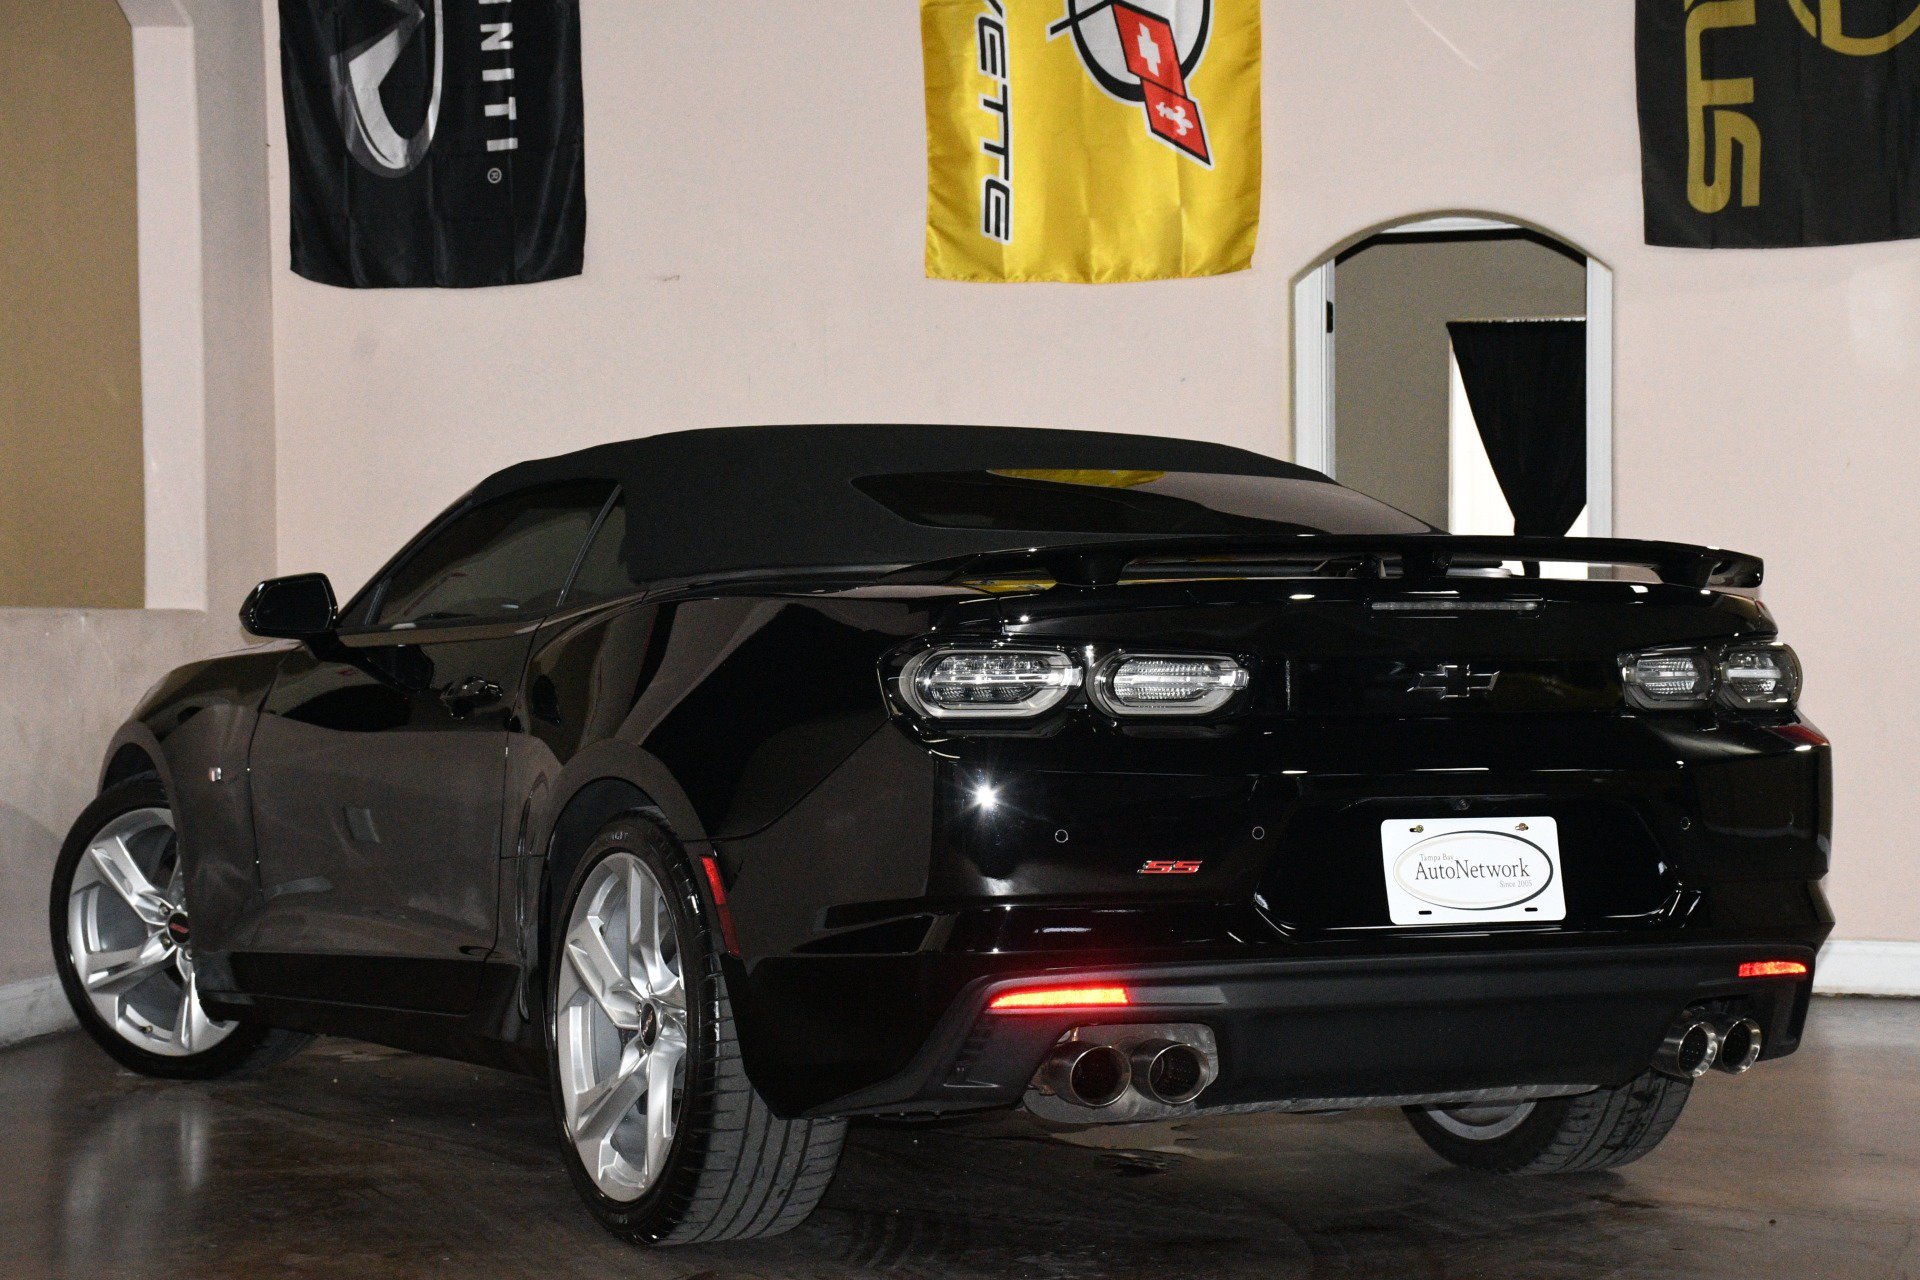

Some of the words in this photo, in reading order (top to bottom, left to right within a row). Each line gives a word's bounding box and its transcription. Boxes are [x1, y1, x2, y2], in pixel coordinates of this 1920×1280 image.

[479, 0, 518, 151] NITI
[1683, 0, 1761, 213] US
[1420, 853, 1441, 862] Tampa
[1442, 853, 1454, 861] Bay
[1137, 860, 1202, 874] SS
[1415, 857, 1530, 880] AutoNetwork
[1499, 880, 1516, 888] Since
